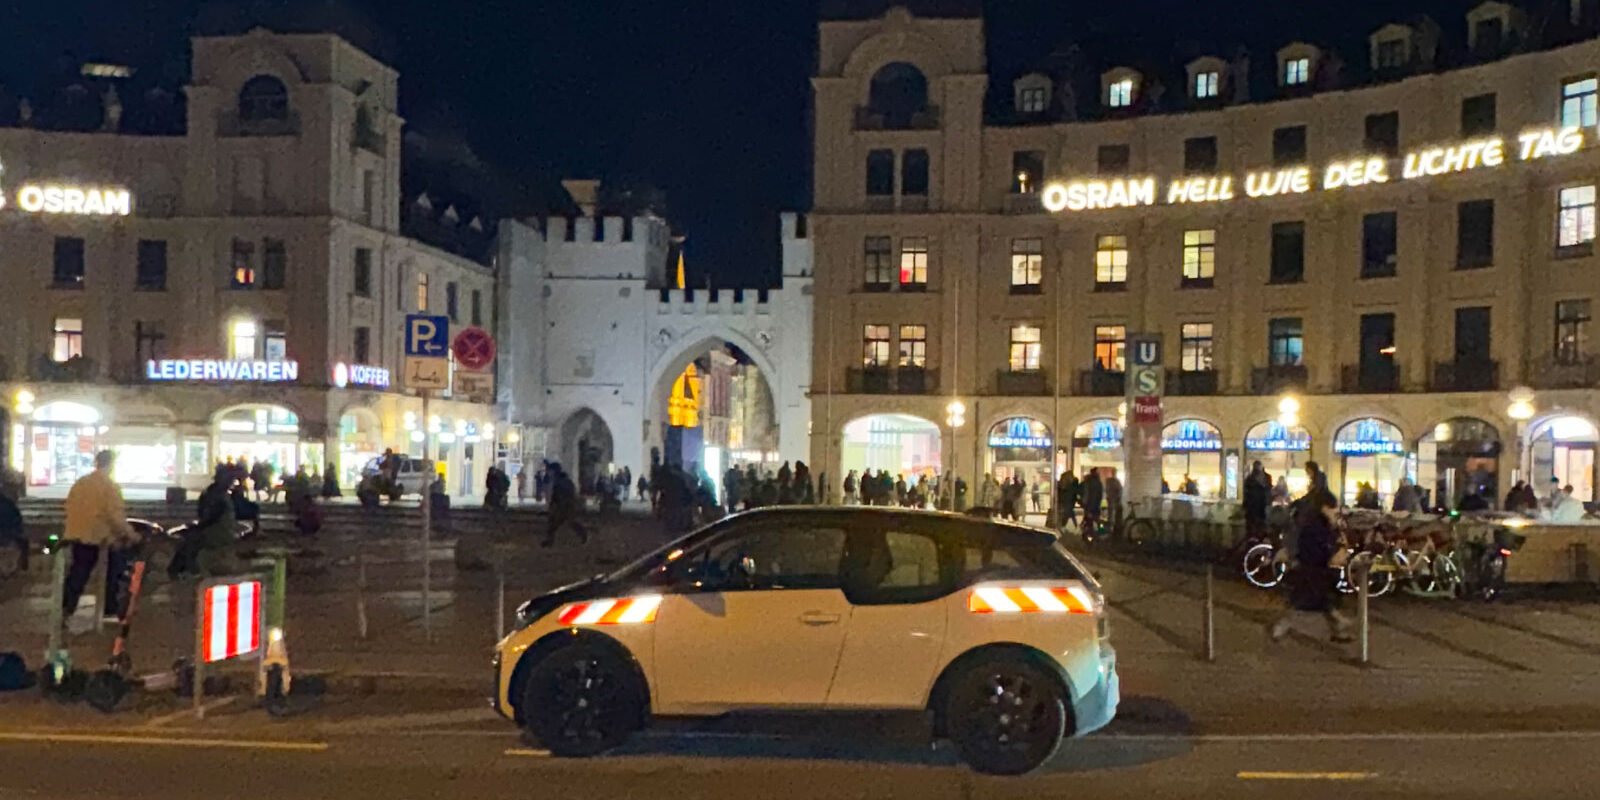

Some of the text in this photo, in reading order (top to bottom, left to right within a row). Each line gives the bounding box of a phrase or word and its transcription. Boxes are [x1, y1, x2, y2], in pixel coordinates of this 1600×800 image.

[1043, 126, 1584, 213] OSRAM HELL WIE DER LICHTE TAG
[18, 184, 131, 216] OSRAM
[411, 319, 437, 353] P
[1140, 342, 1156, 363] U
[147, 359, 298, 381] LEDERWAREN
[350, 364, 390, 387] KOFFER
[1139, 369, 1157, 393] S
[989, 437, 1051, 447] McDonald's
[1335, 441, 1403, 452] McDonald's
